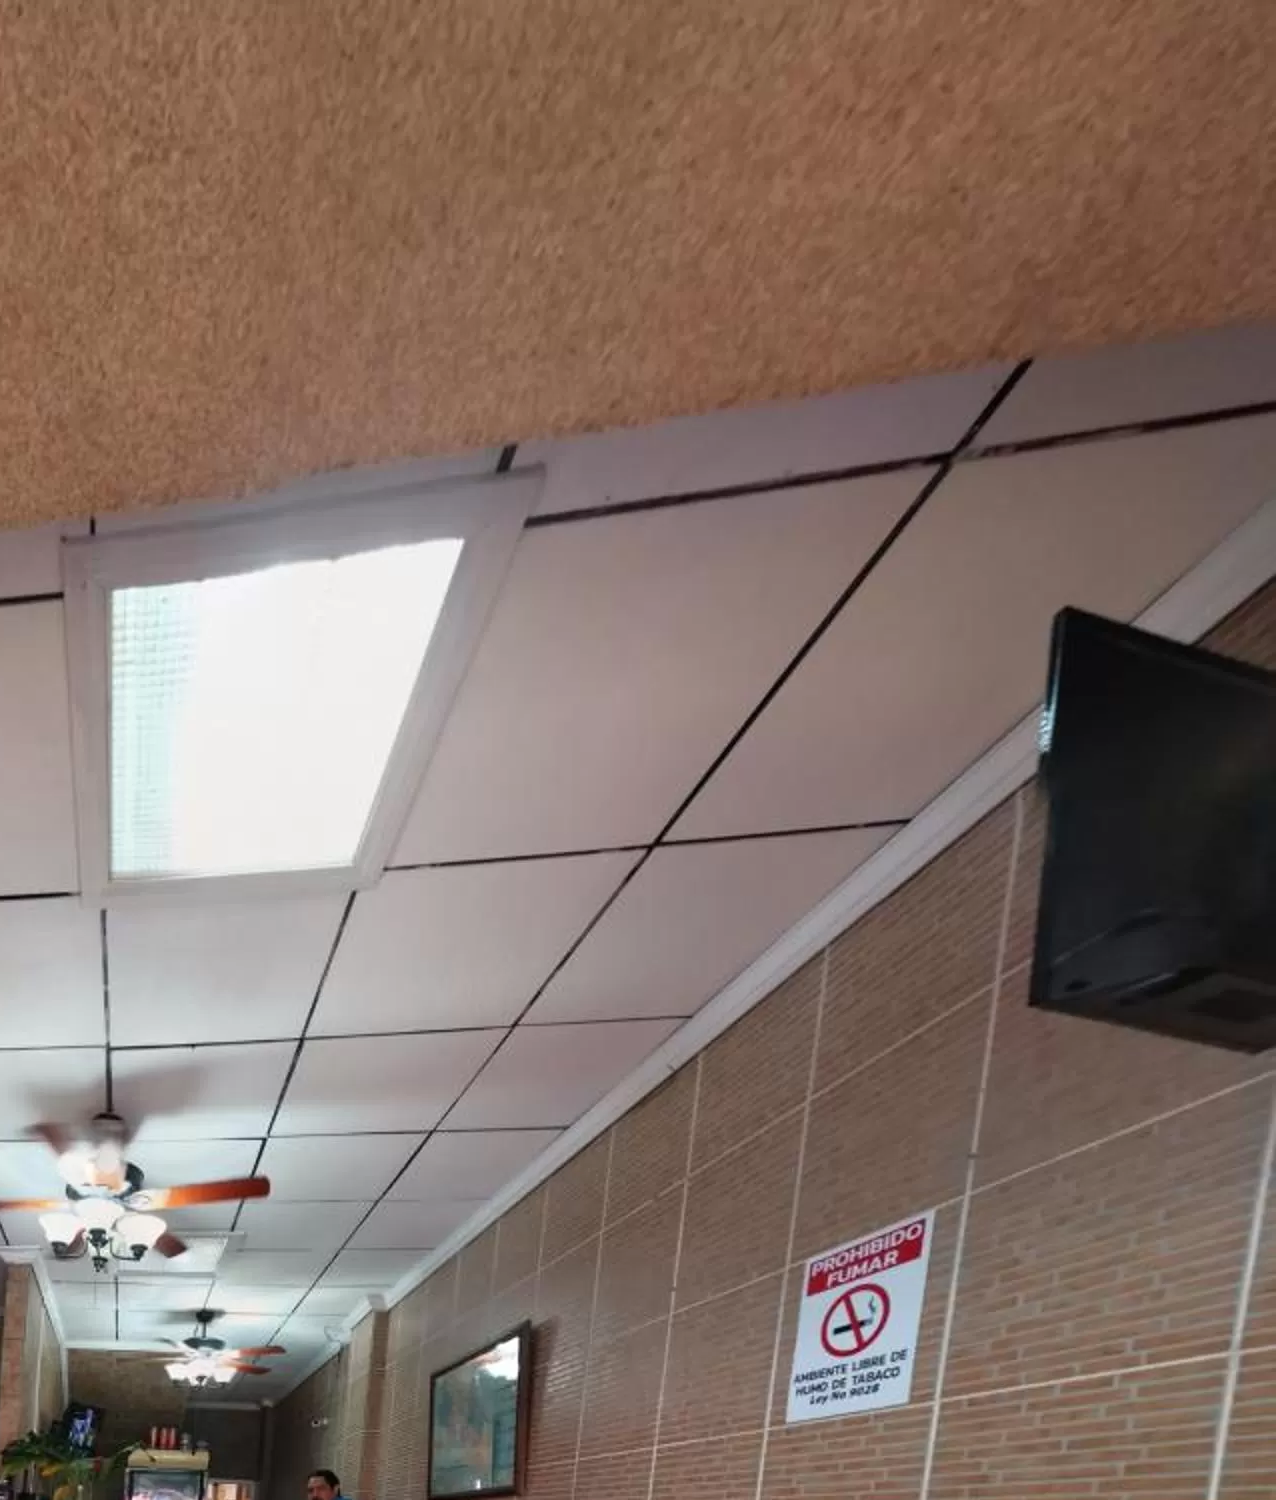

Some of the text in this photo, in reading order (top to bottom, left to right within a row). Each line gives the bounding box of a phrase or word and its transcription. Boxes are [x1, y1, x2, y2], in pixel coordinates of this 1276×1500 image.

[811, 1223, 923, 1276] PROHIBIDO
[827, 1249, 899, 1286] FUMAR
[794, 1349, 908, 1382] AMBIENTE LIBRE DE
[795, 1366, 901, 1397] HUMO DE TABACO
[809, 1395, 829, 1406] Ley
[849, 1383, 881, 1398] 9028
